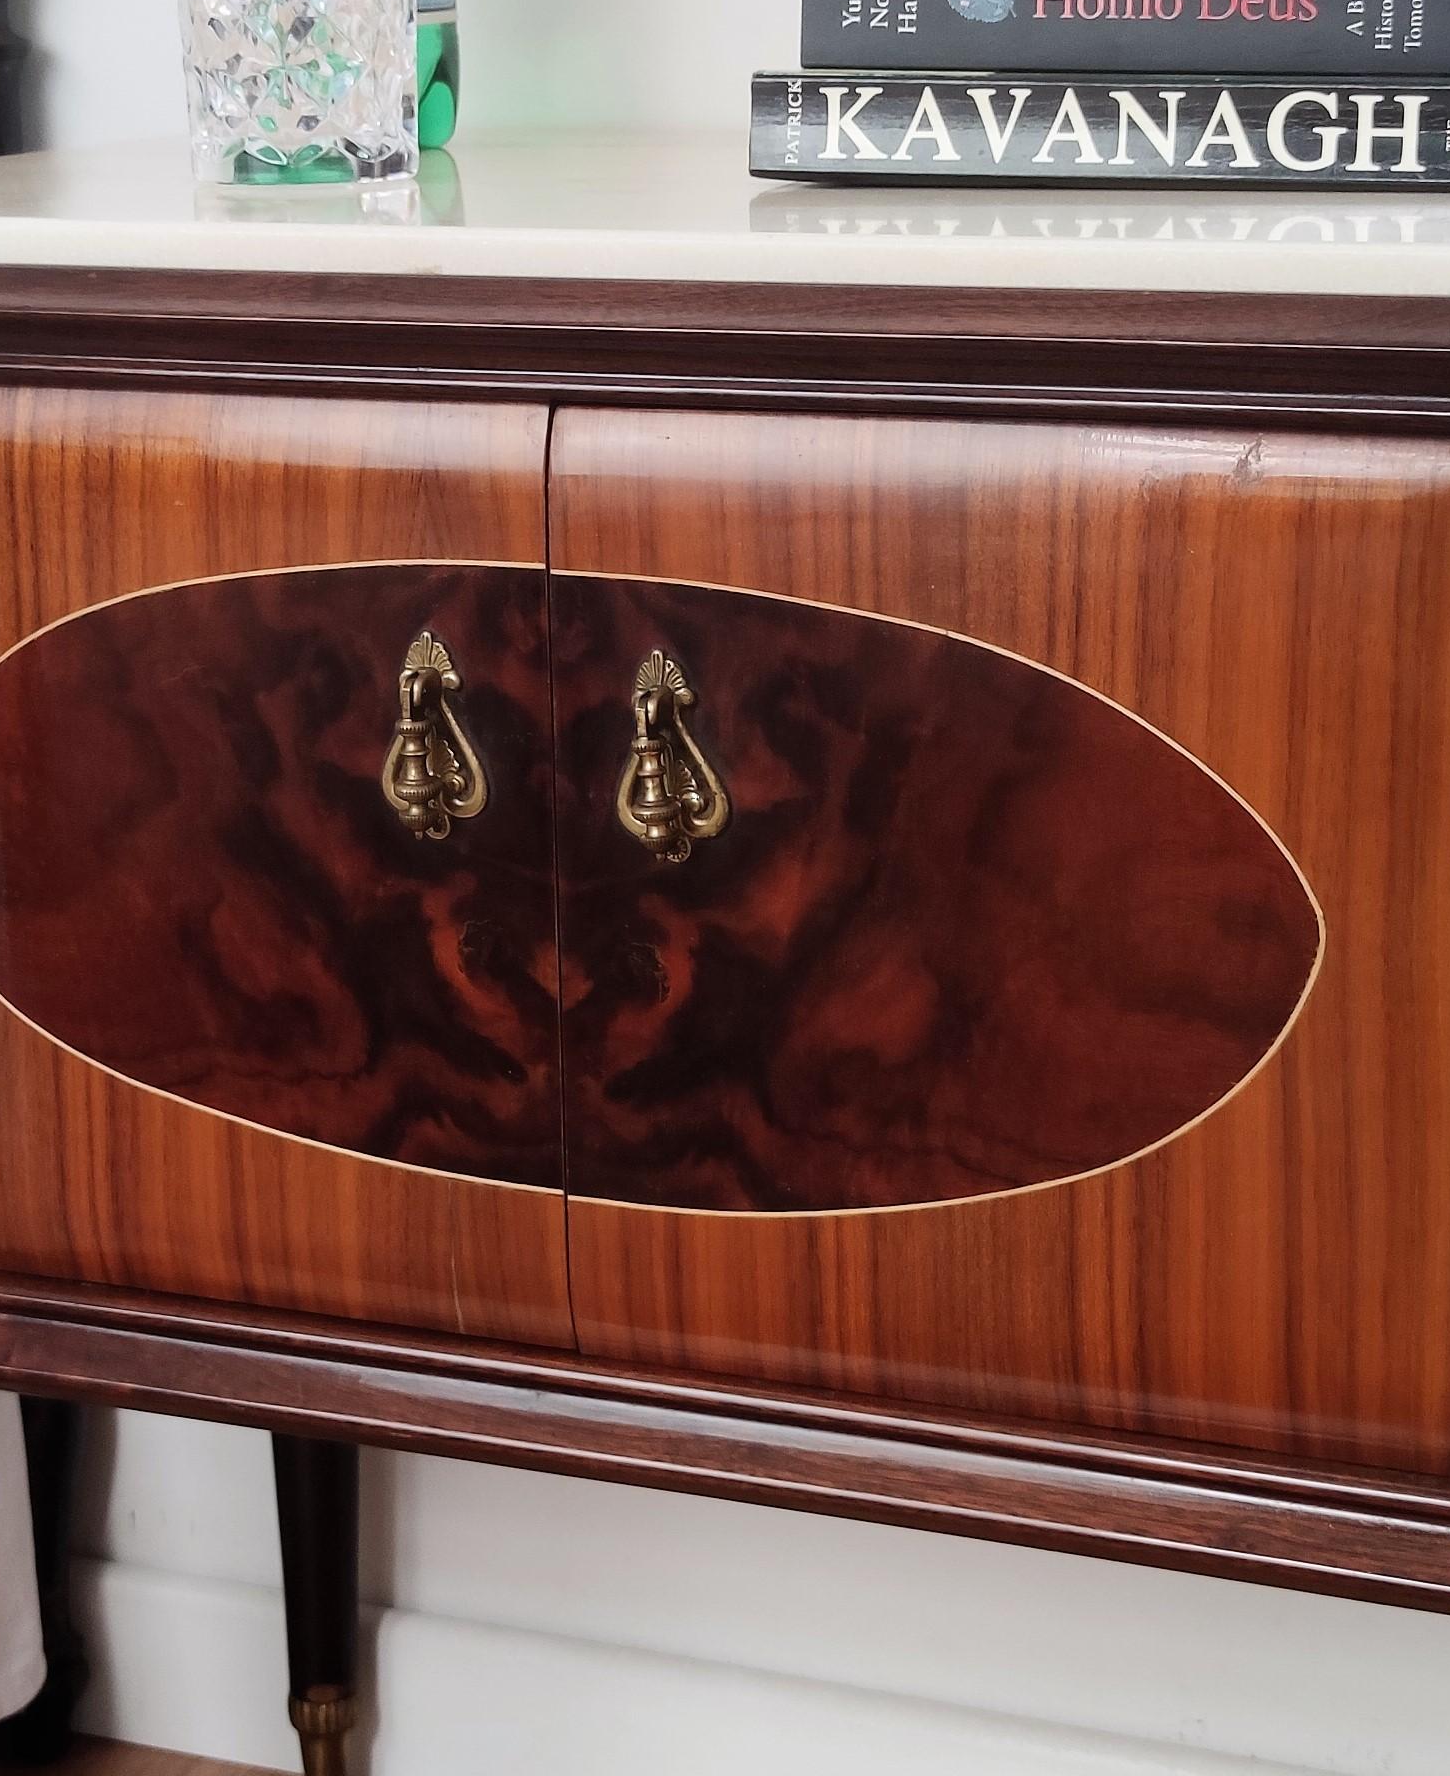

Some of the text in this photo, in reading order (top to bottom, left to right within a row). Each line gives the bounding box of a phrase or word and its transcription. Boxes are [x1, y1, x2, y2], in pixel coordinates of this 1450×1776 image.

[1346, 21, 1364, 37] A
[785, 80, 802, 165] PATRICK
[817, 85, 1430, 173] KAVANAGH
